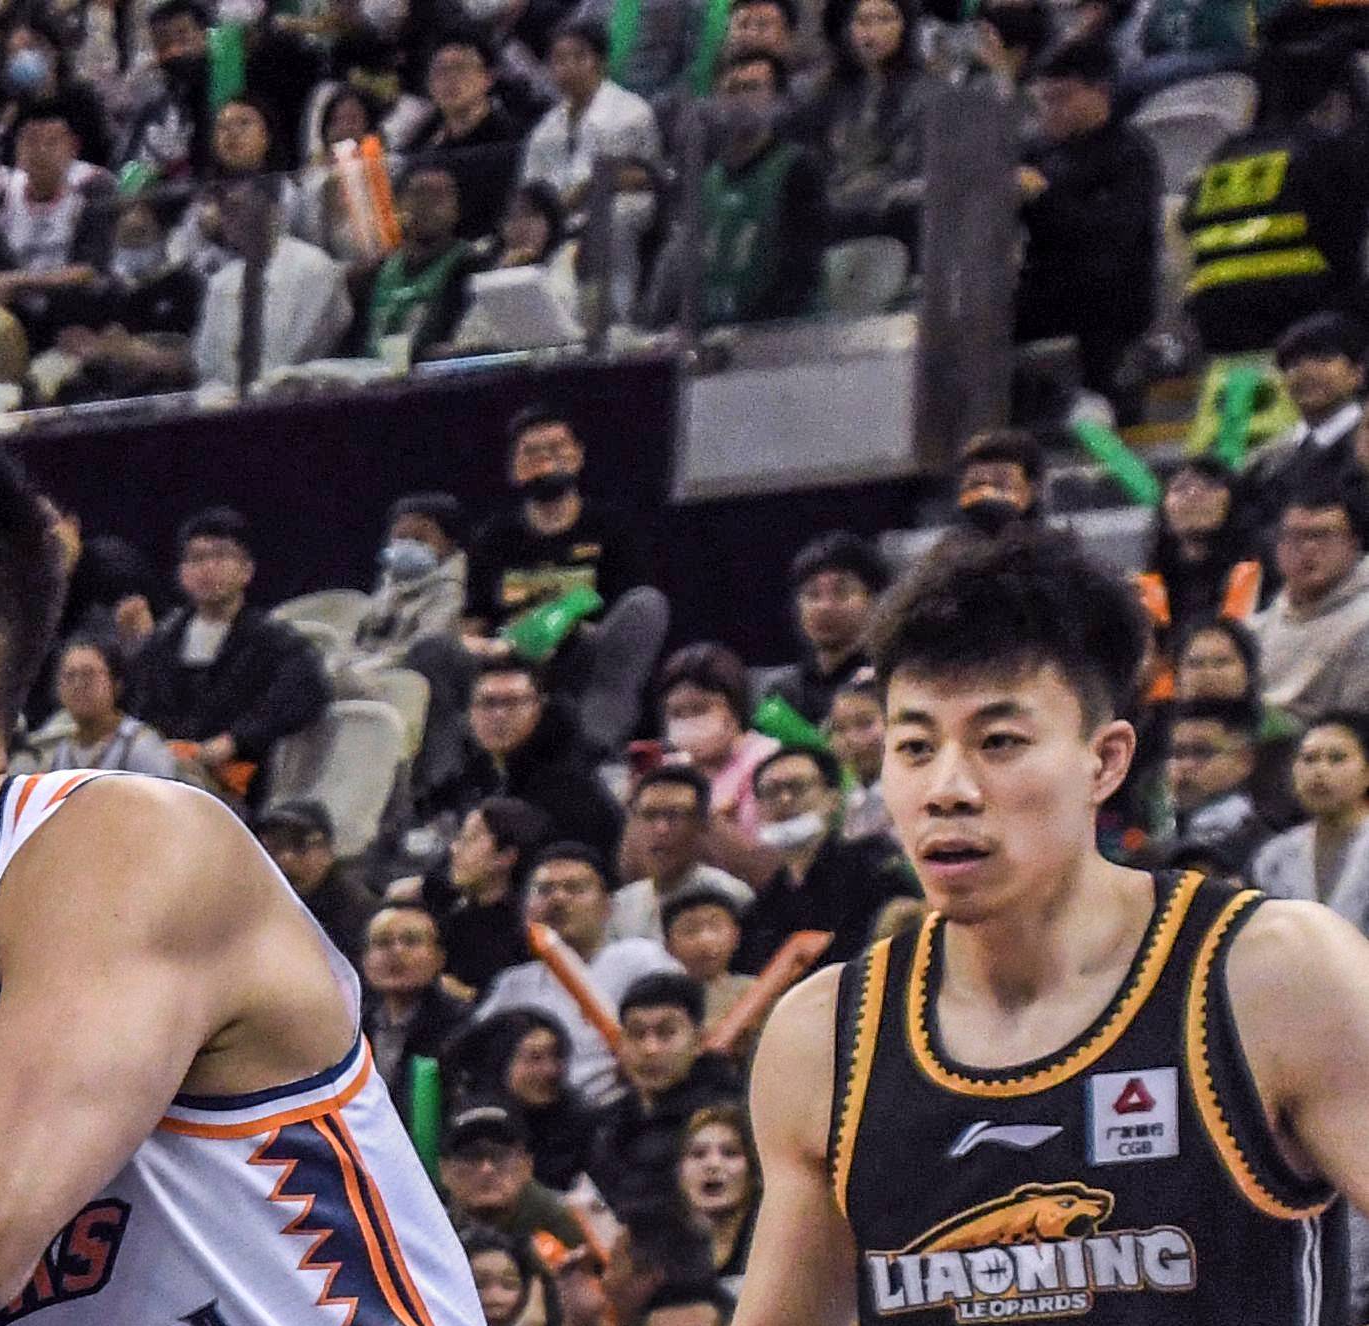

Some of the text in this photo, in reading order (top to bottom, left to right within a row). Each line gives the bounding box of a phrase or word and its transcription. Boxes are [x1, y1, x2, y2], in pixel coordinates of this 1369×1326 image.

[1117, 1140, 1154, 1156] CGB
[865, 1227, 1197, 1315] LIAONING
[958, 1291, 1089, 1319] LEOPARDS
